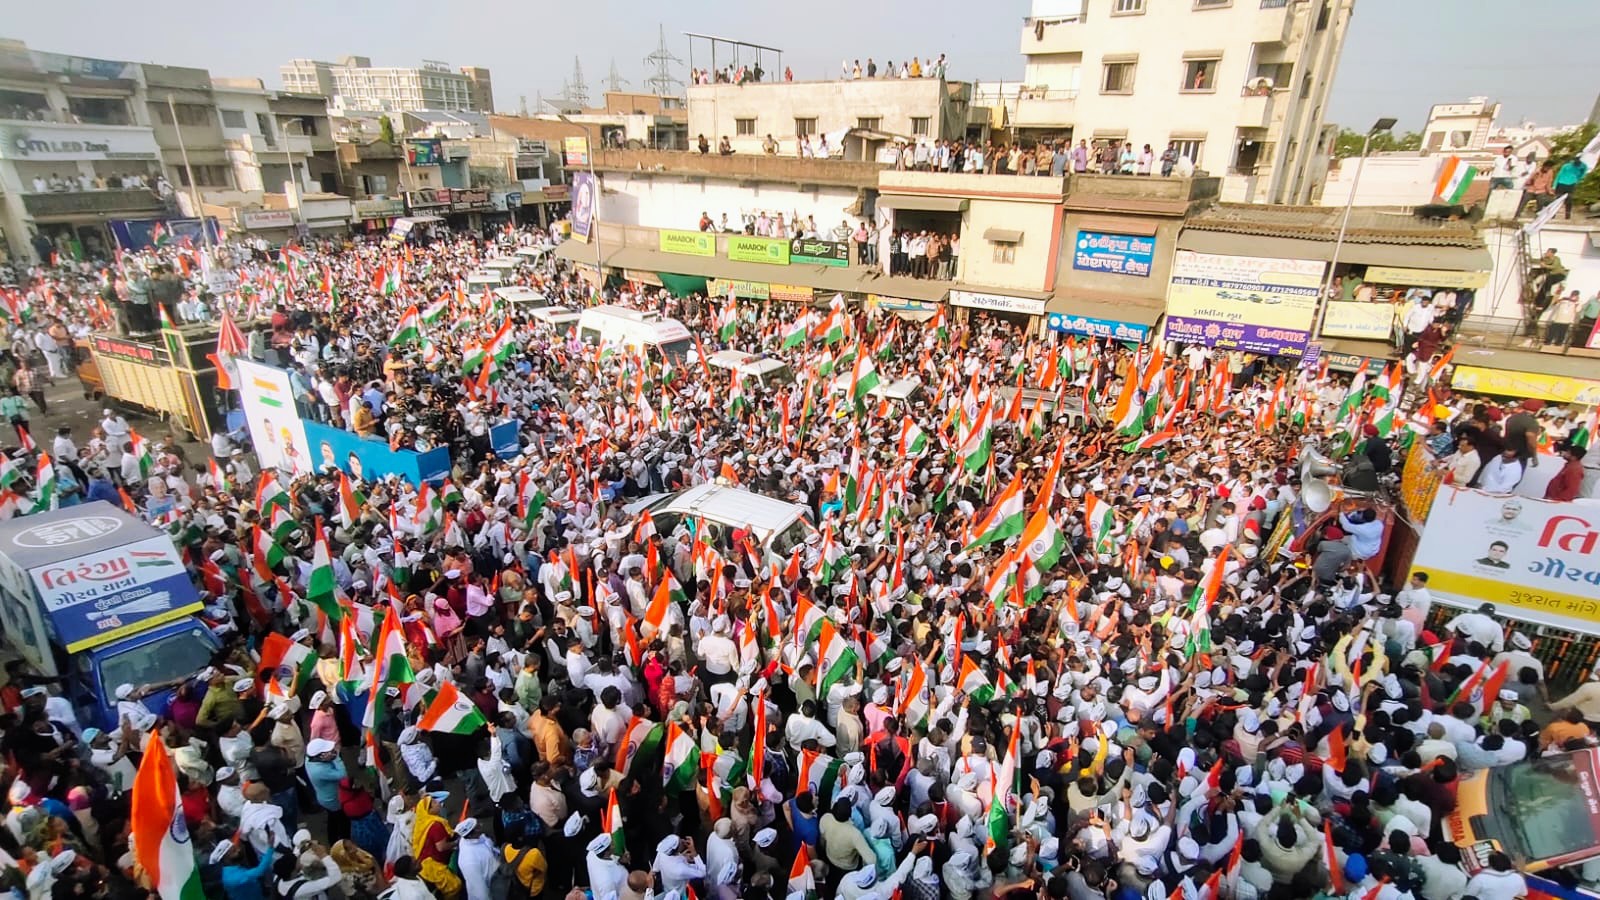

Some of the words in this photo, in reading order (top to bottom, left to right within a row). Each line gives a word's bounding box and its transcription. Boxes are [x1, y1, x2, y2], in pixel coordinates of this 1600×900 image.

[51, 141, 83, 153] LED
[83, 141, 109, 152] Zone
[667, 234, 695, 244] AMARON
[737, 242, 767, 252] AMARON
[42, 557, 131, 590] તિરંગા
[55, 583, 98, 606] ગૌરવ
[102, 577, 137, 592] યાત્રા
[1509, 590, 1561, 608] ગુજરાત
